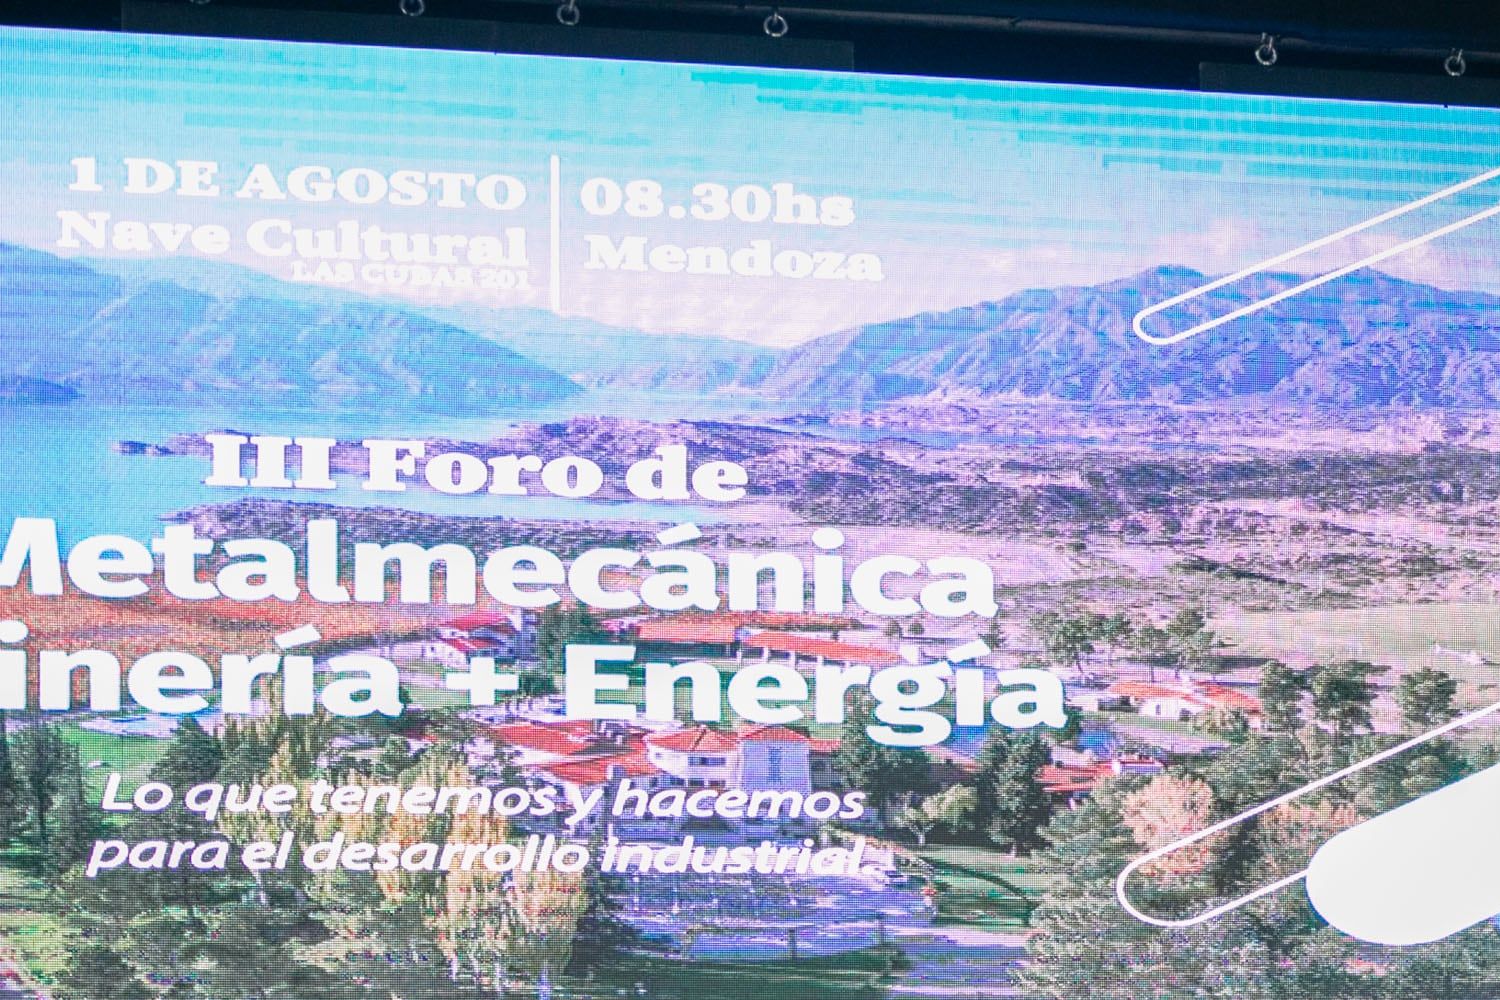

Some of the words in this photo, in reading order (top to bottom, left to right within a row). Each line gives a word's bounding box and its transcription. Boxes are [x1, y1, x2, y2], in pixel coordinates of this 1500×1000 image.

[68, 156, 103, 192] 1
[123, 158, 220, 197] DE
[235, 163, 527, 210] AGOSTO
[580, 177, 856, 227] 08.30hs
[56, 210, 231, 254] Nave
[246, 218, 530, 267] Cultural
[583, 234, 886, 282] Mendoza
[204, 434, 338, 489] III
[362, 439, 604, 498] Foro
[625, 443, 749, 502] de
[0, 517, 999, 620] Metalmecánica
[565, 640, 1068, 748] Energía
[101, 772, 173, 813] Lo
[185, 781, 298, 822] que
[311, 778, 558, 817] tenemos
[563, 788, 604, 825] y
[612, 778, 865, 820] hacemos
[86, 838, 230, 877] para
[243, 831, 295, 870] el
[303, 831, 591, 874] desarrollo
[600, 835, 882, 877] industrial.
